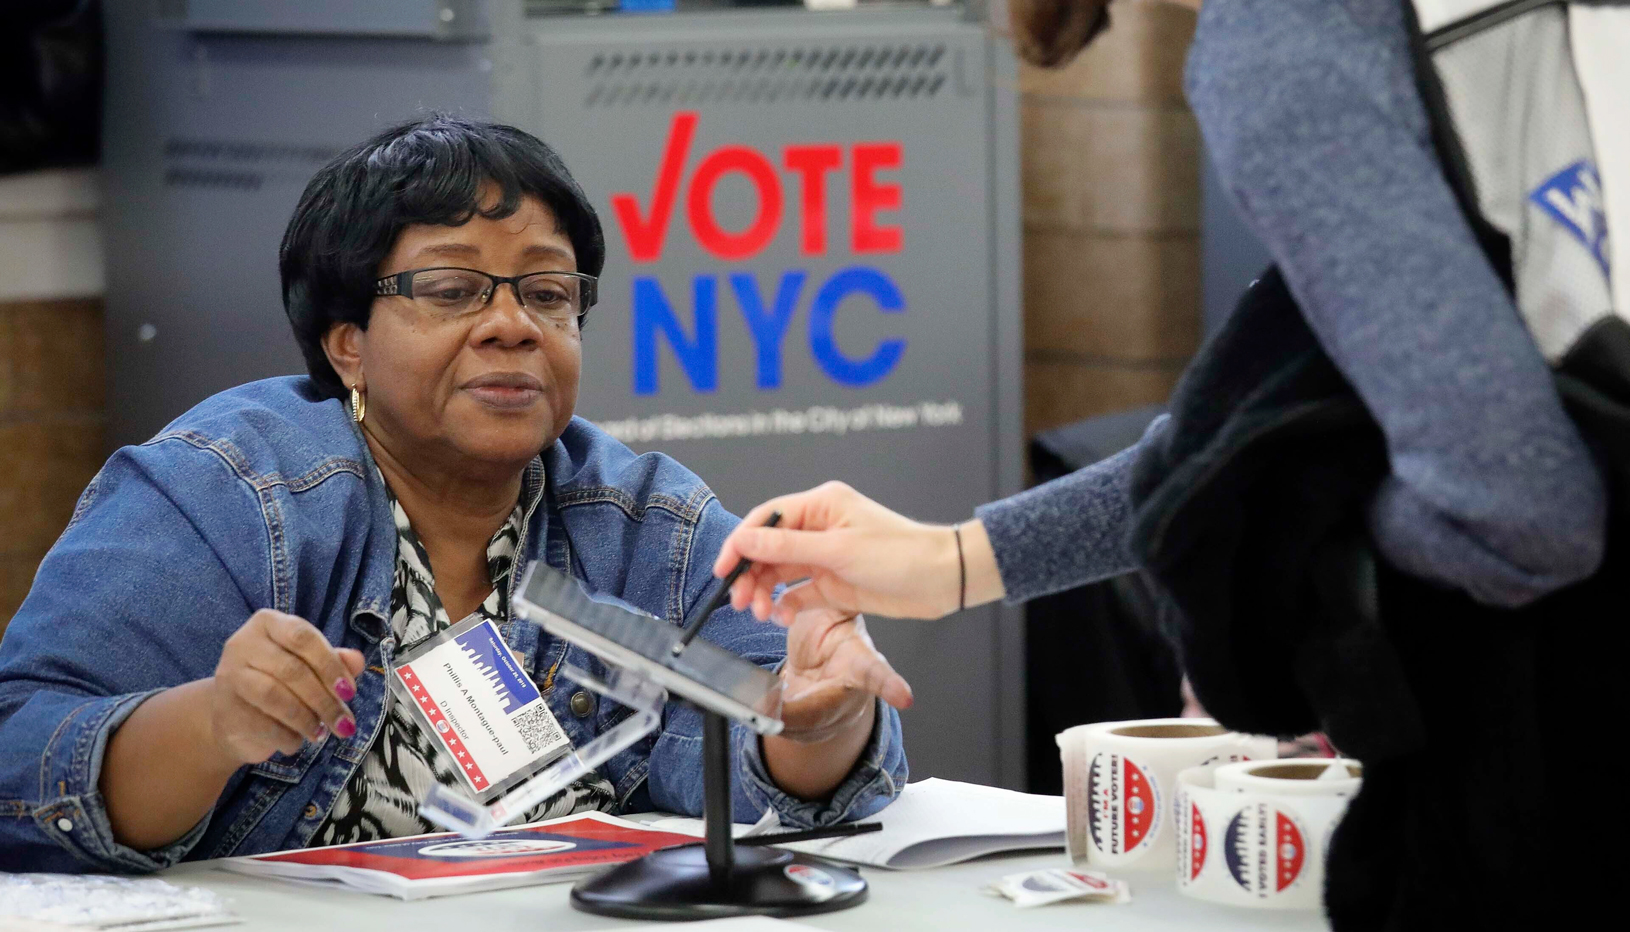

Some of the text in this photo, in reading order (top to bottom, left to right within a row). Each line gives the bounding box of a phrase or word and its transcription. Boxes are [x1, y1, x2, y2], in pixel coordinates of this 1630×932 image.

[632, 266, 906, 396] NYC
[806, 404, 847, 435] City
[874, 403, 917, 430] New
[920, 401, 962, 427] York
[440, 700, 448, 708] D
[443, 662, 509, 756] Phillis A Montague-paul
[1111, 754, 1119, 854] FUTURE VOTER!
[1258, 850, 1268, 890] VOTED
